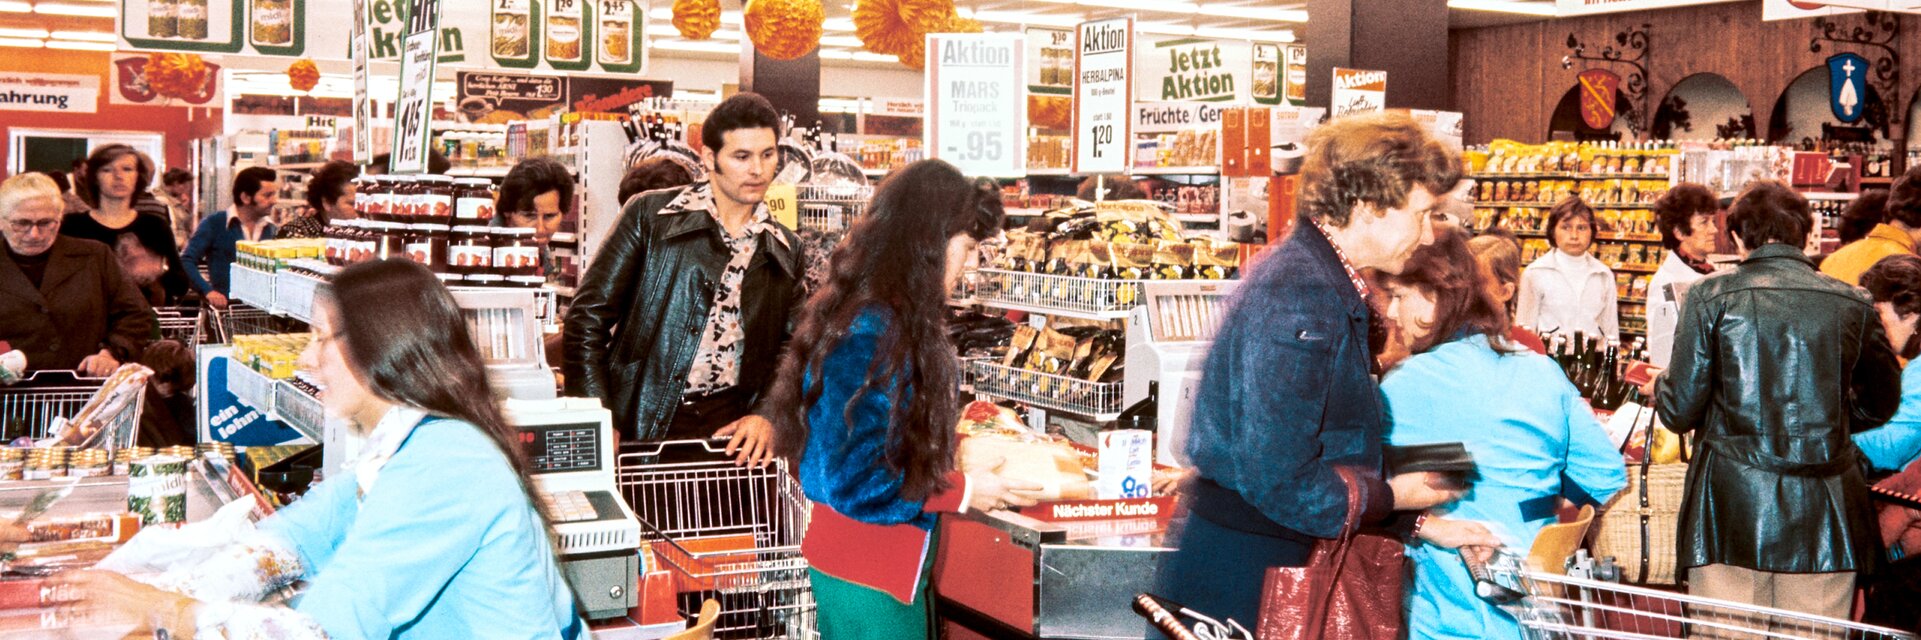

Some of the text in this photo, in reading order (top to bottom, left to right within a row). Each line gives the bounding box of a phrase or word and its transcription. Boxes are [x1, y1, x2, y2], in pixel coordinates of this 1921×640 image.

[1083, 23, 1124, 53] Aktion
[943, 39, 1010, 65] Aktion
[1170, 45, 1222, 73] Jetzt
[1082, 68, 1124, 84] HERBALPINA
[1162, 71, 1234, 100] Aktion
[1336, 70, 1385, 89] Aktion
[0, 90, 69, 109] ahrung
[951, 80, 1000, 99] MARS
[1139, 106, 1190, 125] Früchte
[947, 130, 1002, 160] -.95
[1092, 125, 1113, 158] 1.20
[210, 405, 239, 427] ein
[1053, 501, 1158, 518] Nächster Kunde
